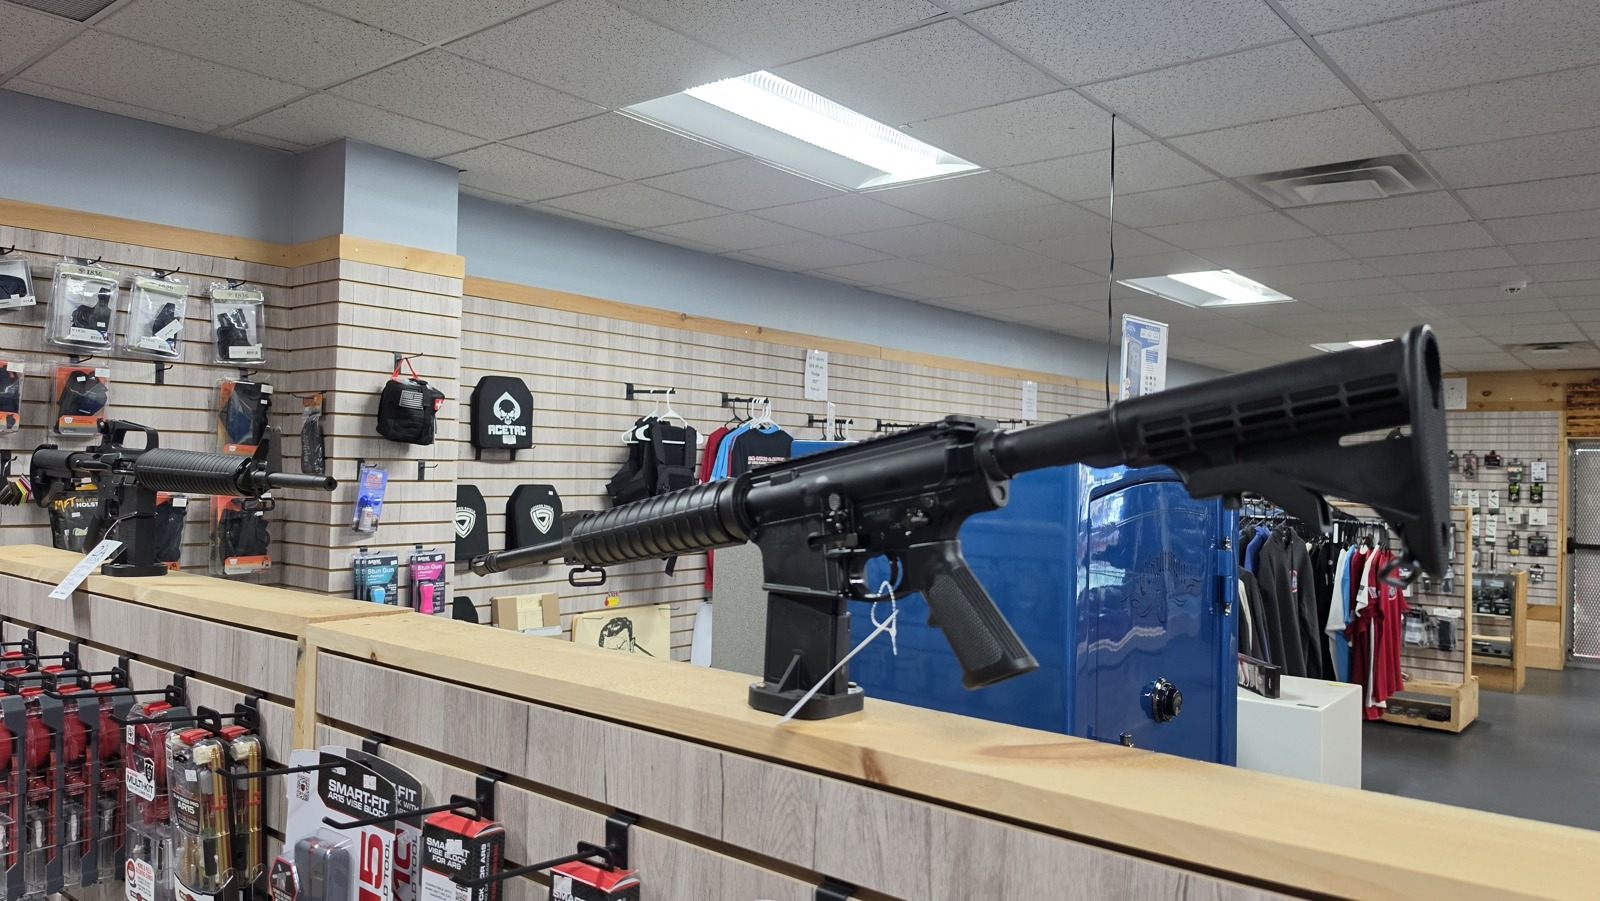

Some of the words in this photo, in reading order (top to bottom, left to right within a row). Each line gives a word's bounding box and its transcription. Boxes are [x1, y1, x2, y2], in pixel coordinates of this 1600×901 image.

[488, 424, 527, 436] ACETAC
[54, 496, 76, 512] MFT
[328, 778, 390, 812] SMART-FIT
[396, 784, 417, 802] FIT
[346, 797, 362, 811] VISE
[383, 839, 391, 880] TOOL
[432, 855, 446, 865] FOR
